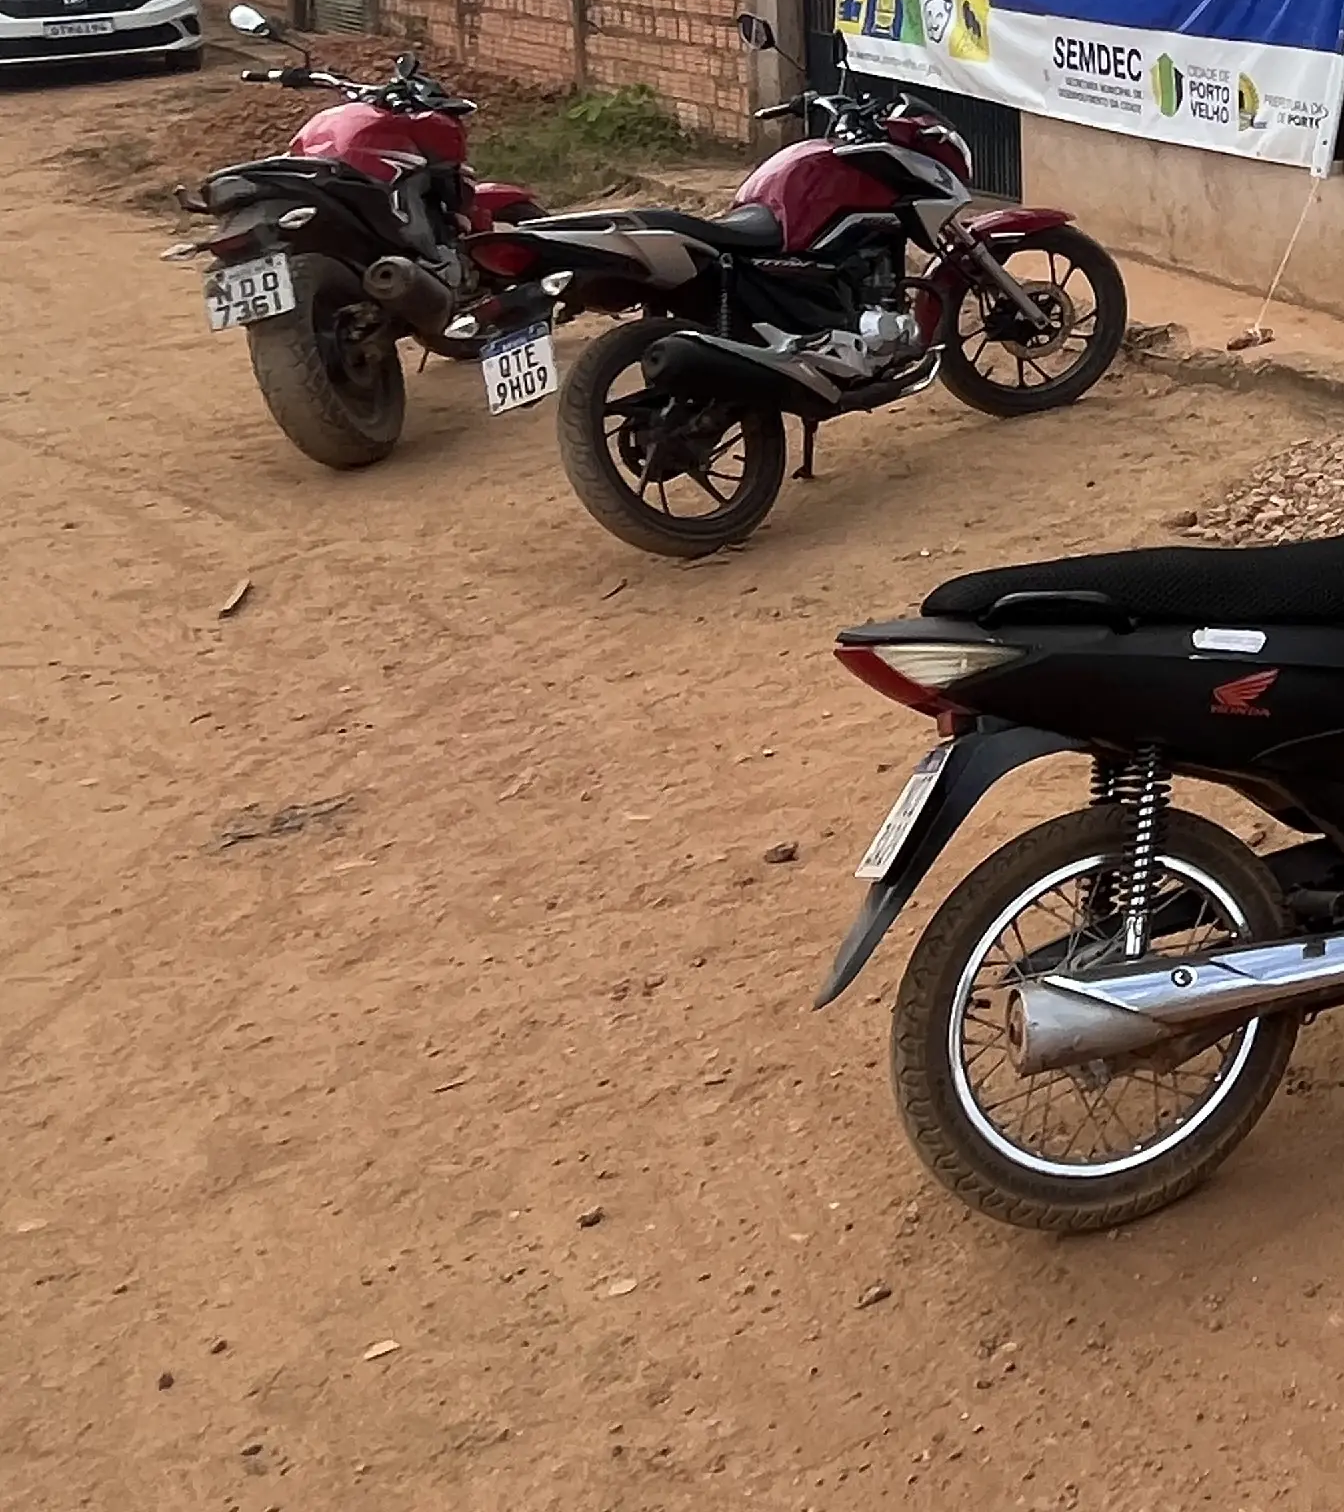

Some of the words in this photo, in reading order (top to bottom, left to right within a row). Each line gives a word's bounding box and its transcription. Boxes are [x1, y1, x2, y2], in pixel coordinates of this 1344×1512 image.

[1053, 37, 1142, 81] SEMDEC
[1188, 80, 1230, 103] PORTO
[1190, 100, 1230, 124] VELHO
[215, 291, 282, 326] 7361
[496, 366, 547, 406] 9H09
